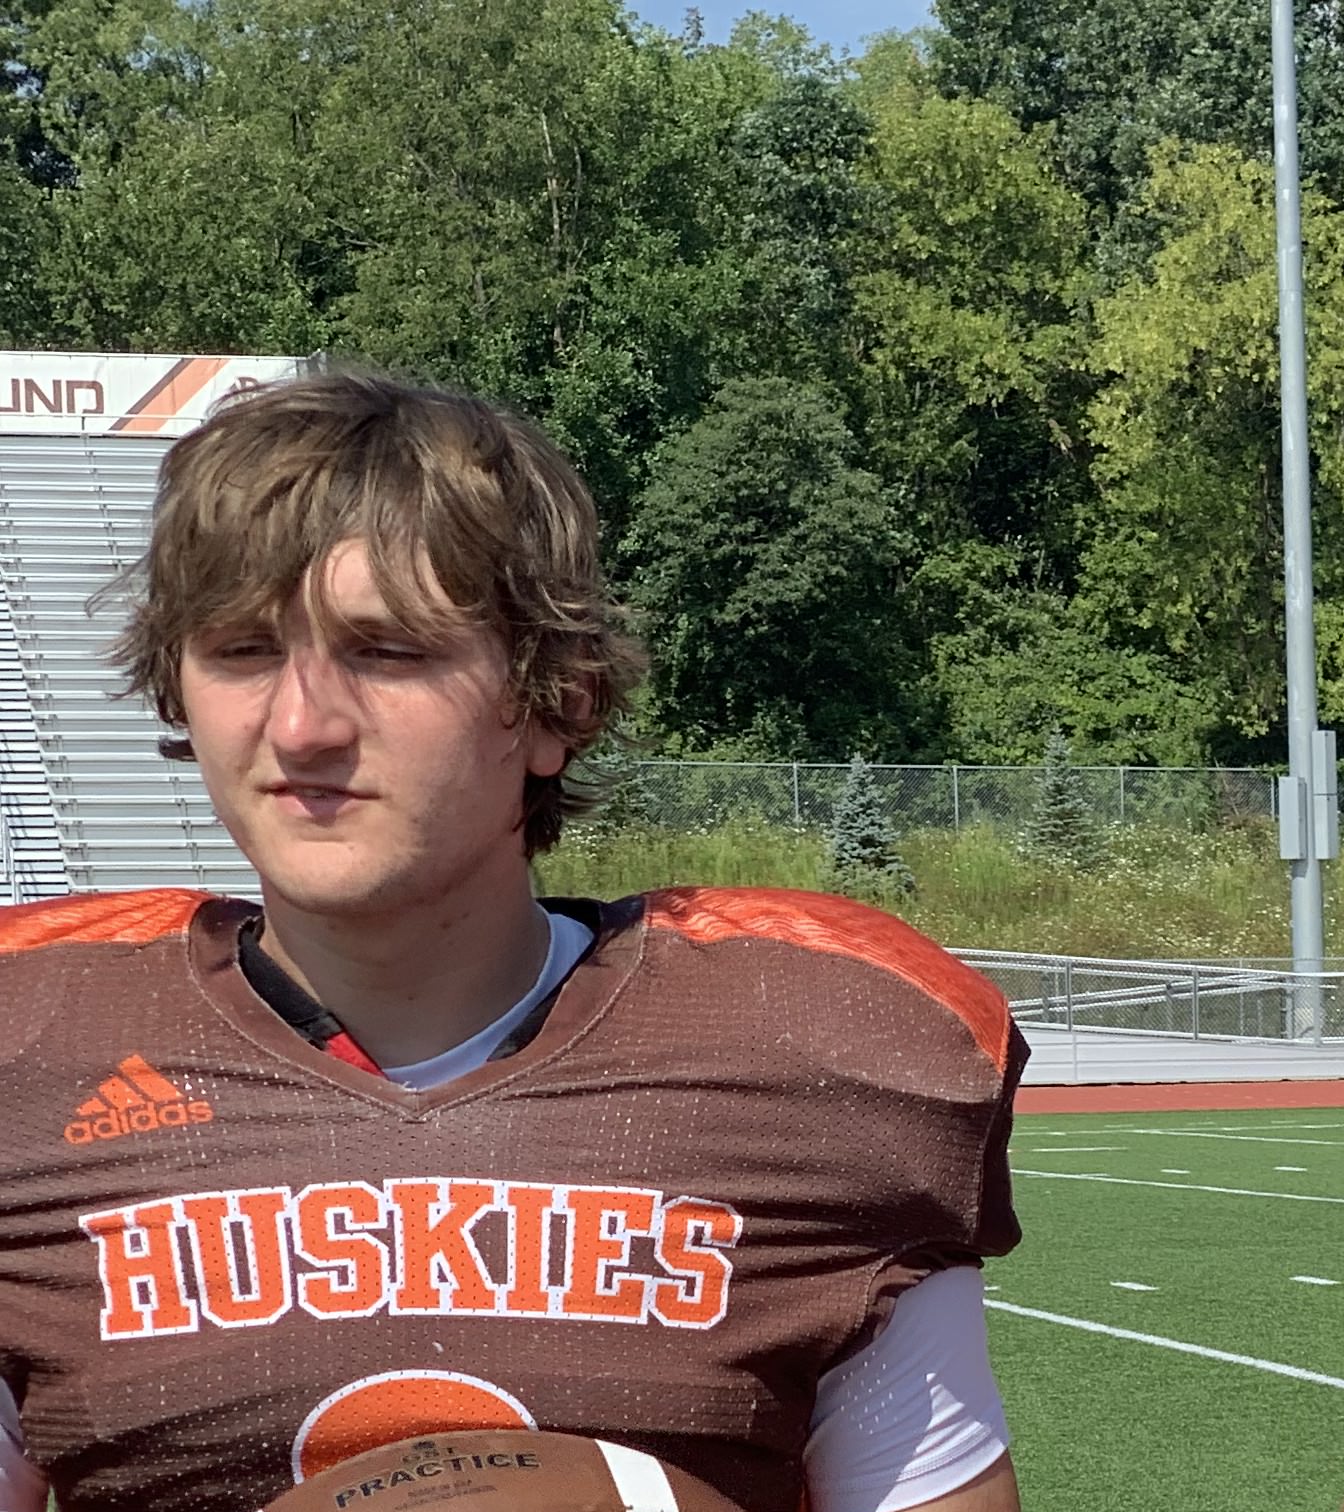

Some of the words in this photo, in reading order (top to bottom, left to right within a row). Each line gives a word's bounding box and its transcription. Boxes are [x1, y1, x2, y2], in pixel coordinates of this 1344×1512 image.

[64, 1096, 214, 1145] adidas
[79, 1177, 743, 1341] HUSKIES
[335, 1452, 542, 1510] PRACTICE
